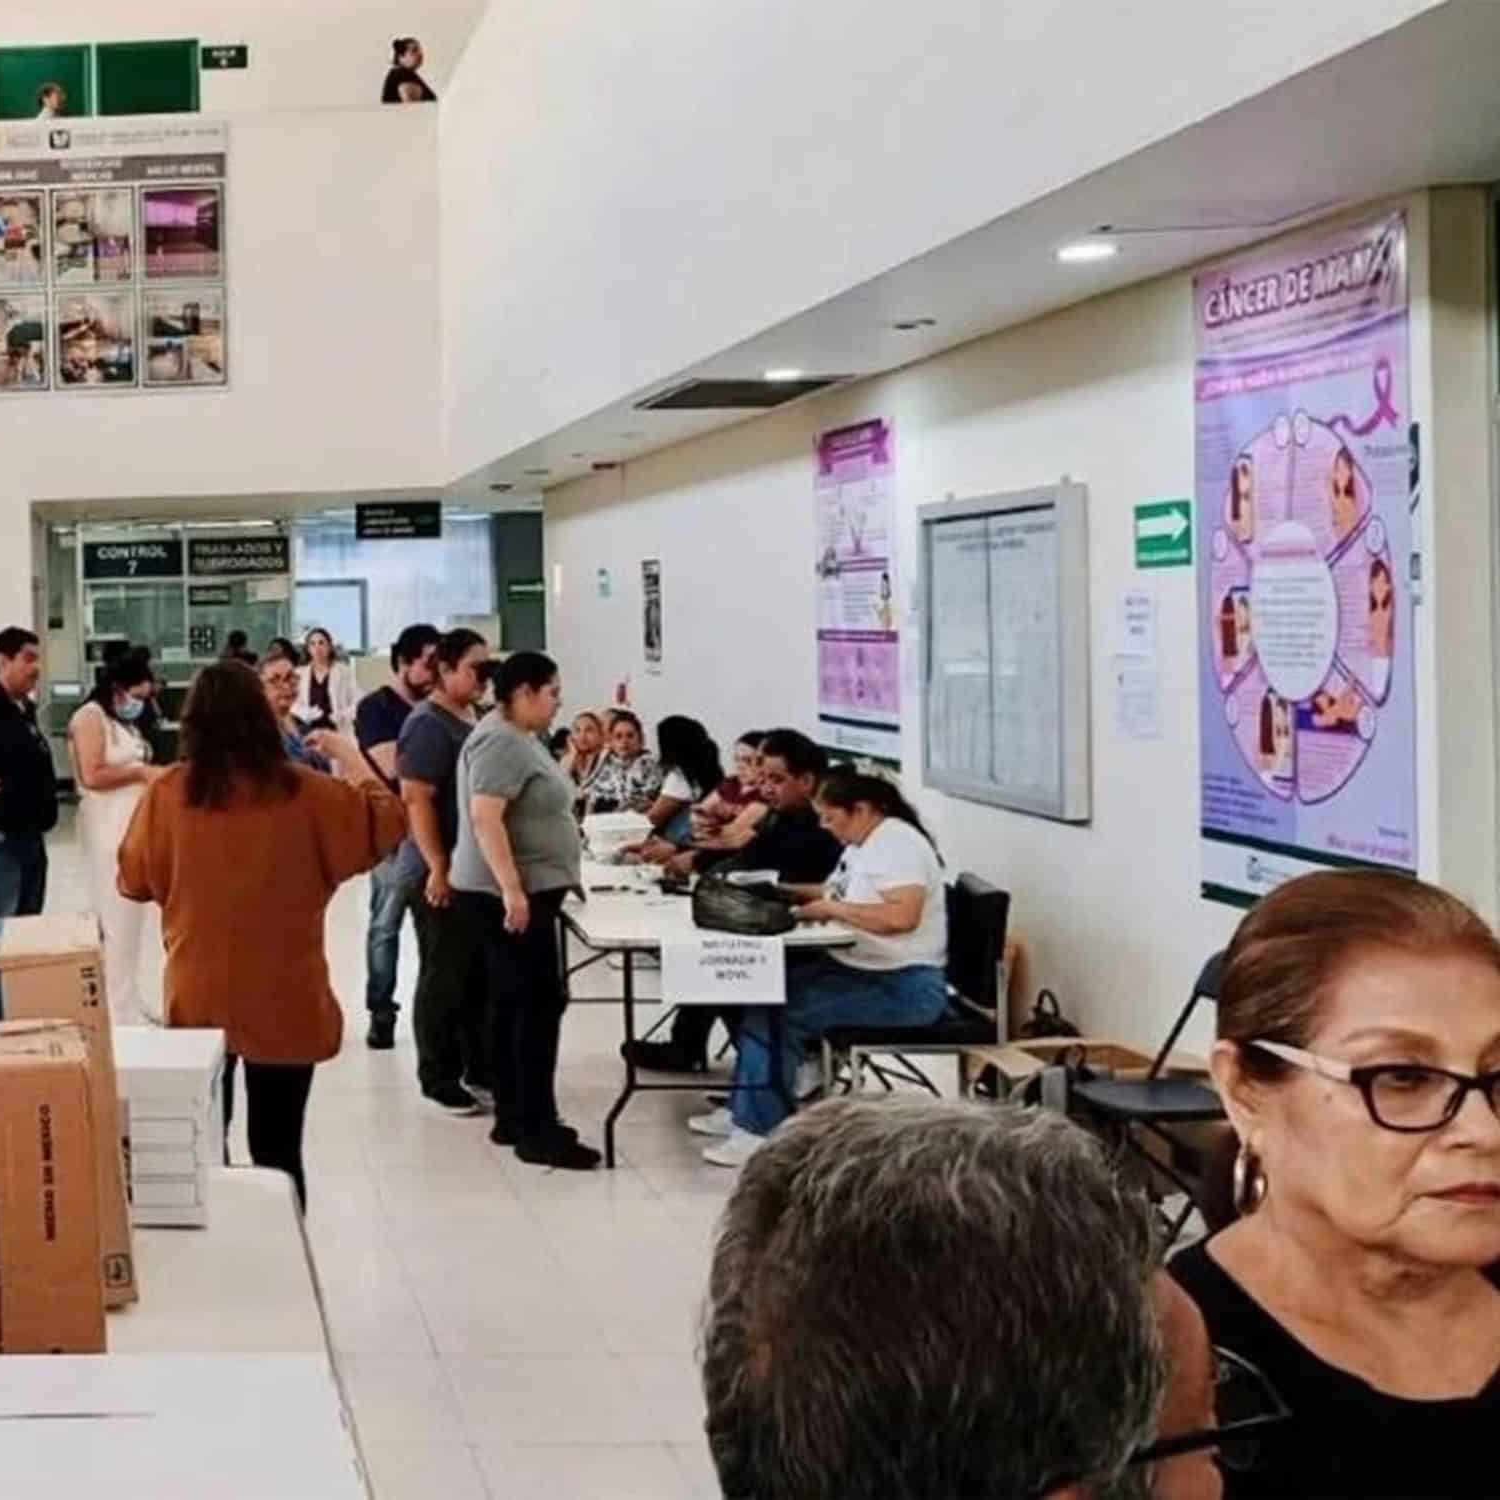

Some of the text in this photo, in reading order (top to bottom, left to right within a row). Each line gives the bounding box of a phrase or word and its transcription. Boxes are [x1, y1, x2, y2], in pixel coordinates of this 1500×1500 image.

[1283, 263, 1314, 308] DE
[97, 545, 168, 560] CONTROL
[126, 560, 139, 575] 7
